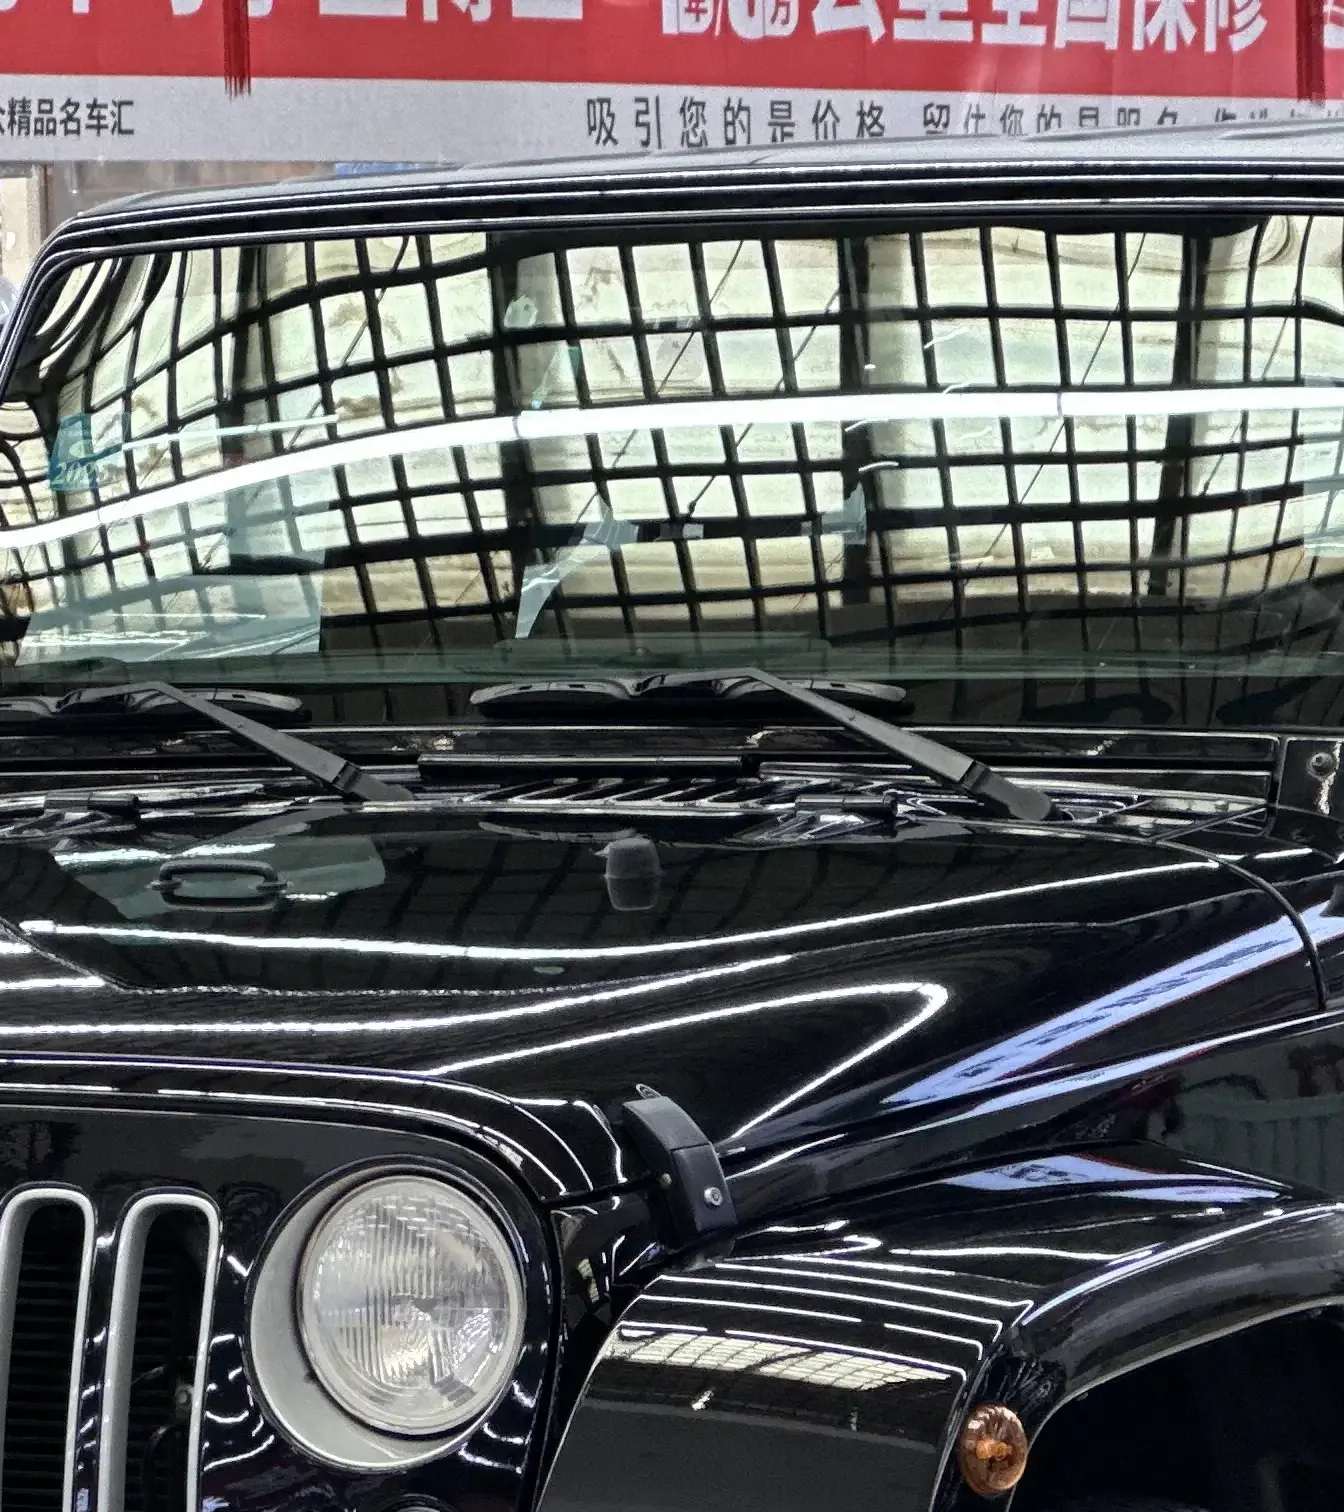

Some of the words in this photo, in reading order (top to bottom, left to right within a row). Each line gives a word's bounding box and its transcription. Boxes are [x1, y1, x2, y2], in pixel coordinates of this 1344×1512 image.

[586, 96, 885, 149] 吸引您的是价格
